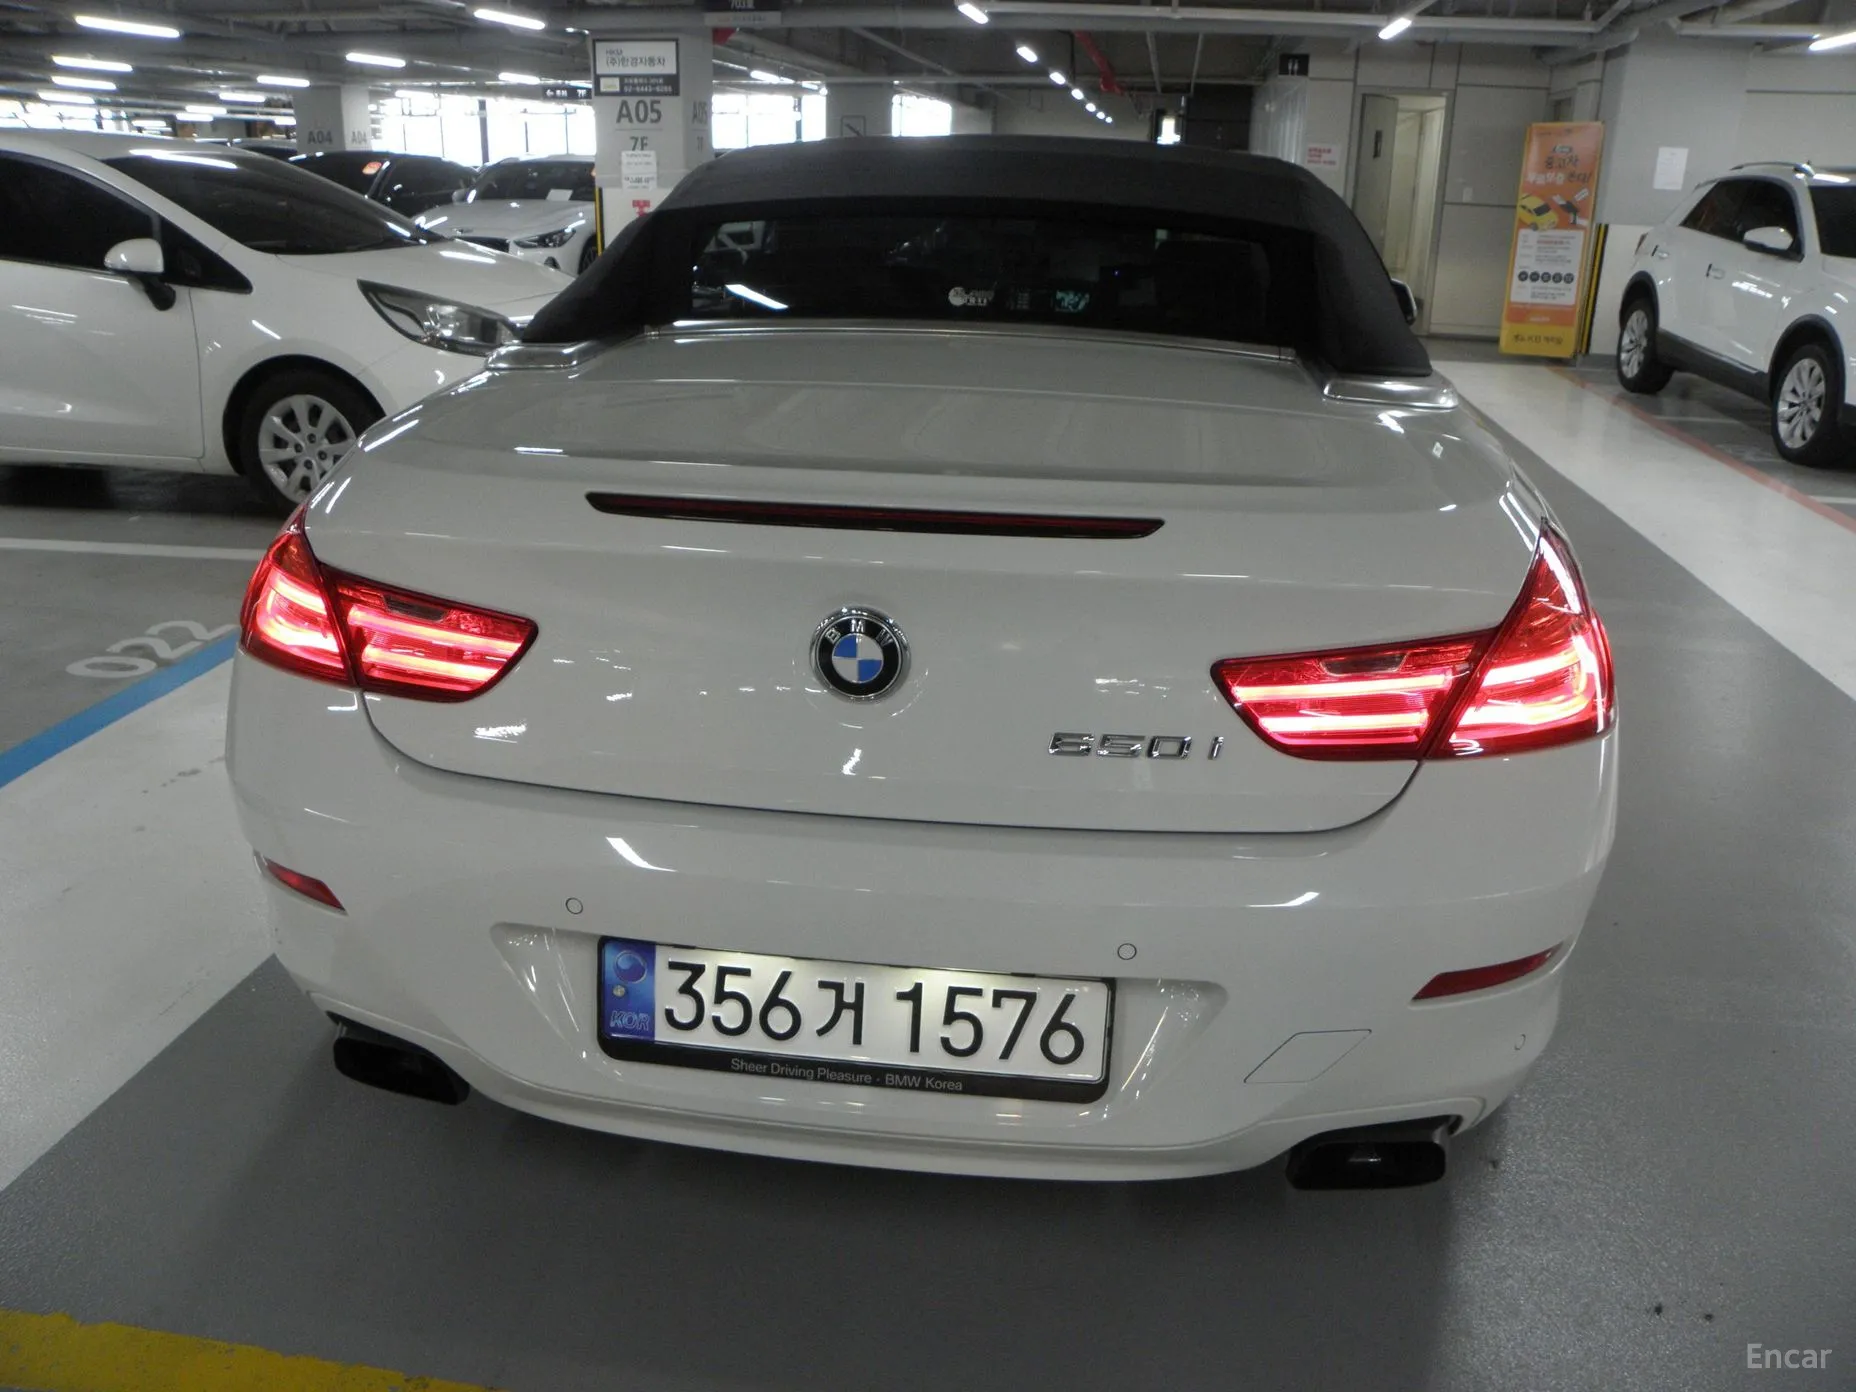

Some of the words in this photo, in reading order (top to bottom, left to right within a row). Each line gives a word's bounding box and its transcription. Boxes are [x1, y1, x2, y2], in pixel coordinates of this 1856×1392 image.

[616, 99, 662, 124] A05
[307, 131, 333, 145] A04
[351, 131, 367, 145] A04
[629, 135, 649, 152] 7F
[825, 618, 893, 647] BMW
[609, 1010, 651, 1032] KOR
[664, 959, 865, 1046] 356거
[896, 981, 1085, 1066] 1576
[730, 1057, 767, 1074] Sheer
[770, 1062, 814, 1080] Driving
[817, 1067, 872, 1085] Pleasure
[885, 1073, 921, 1088] BMW
[925, 1077, 963, 1092] Korea
